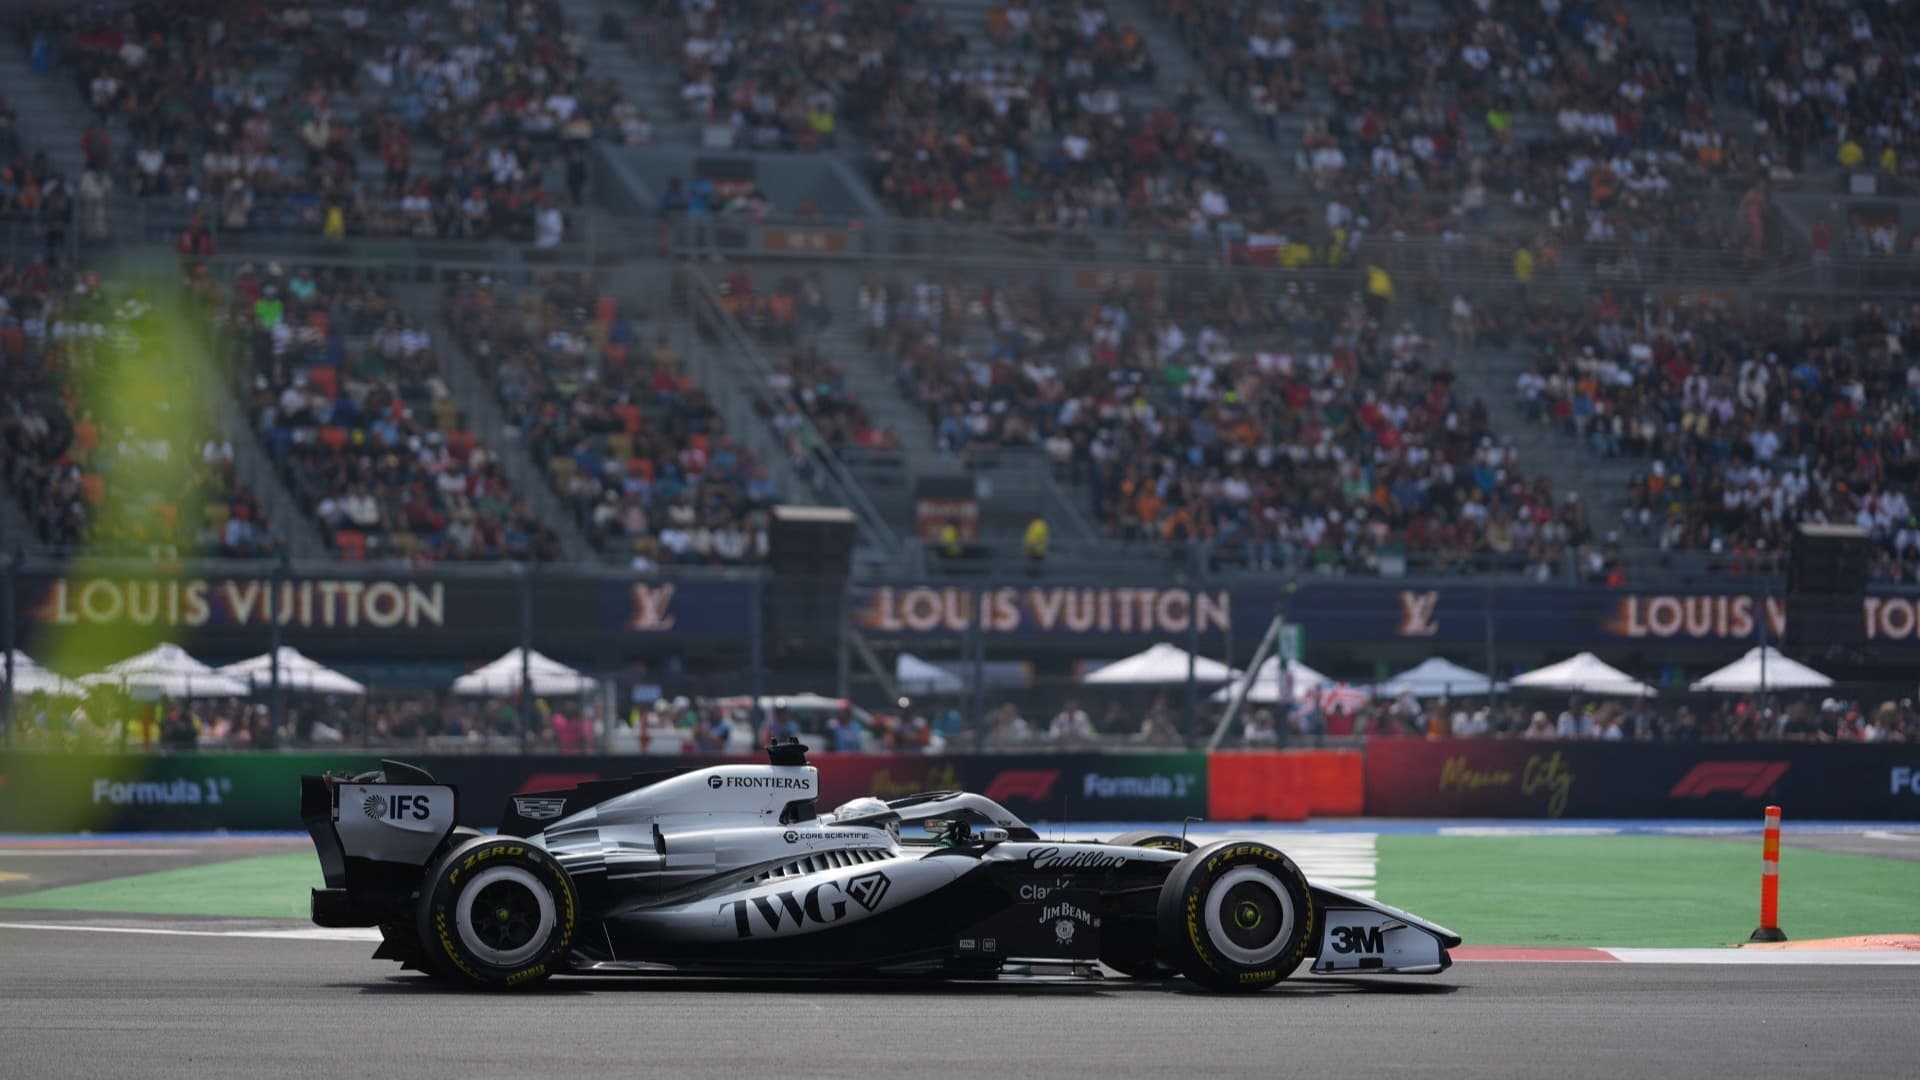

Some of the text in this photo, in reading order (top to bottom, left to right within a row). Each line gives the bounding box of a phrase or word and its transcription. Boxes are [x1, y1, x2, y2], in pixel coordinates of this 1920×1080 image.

[55, 579, 444, 627] LOUIS VUITTON
[880, 587, 1230, 632] LOUIS VUITTON
[1627, 595, 1753, 637] LOUIS
[93, 778, 202, 804] Formula
[726, 776, 810, 790] FRONTIERAS
[1084, 773, 1171, 797] Formula
[389, 795, 430, 820] IFS
[463, 846, 524, 870] ZERO
[1027, 847, 1126, 869] Cadillac
[1222, 846, 1279, 861] ZERO
[718, 880, 847, 938] TWG
[1039, 906, 1060, 924] JIM
[1061, 902, 1091, 926] BEAM
[1331, 926, 1385, 954] 3M
